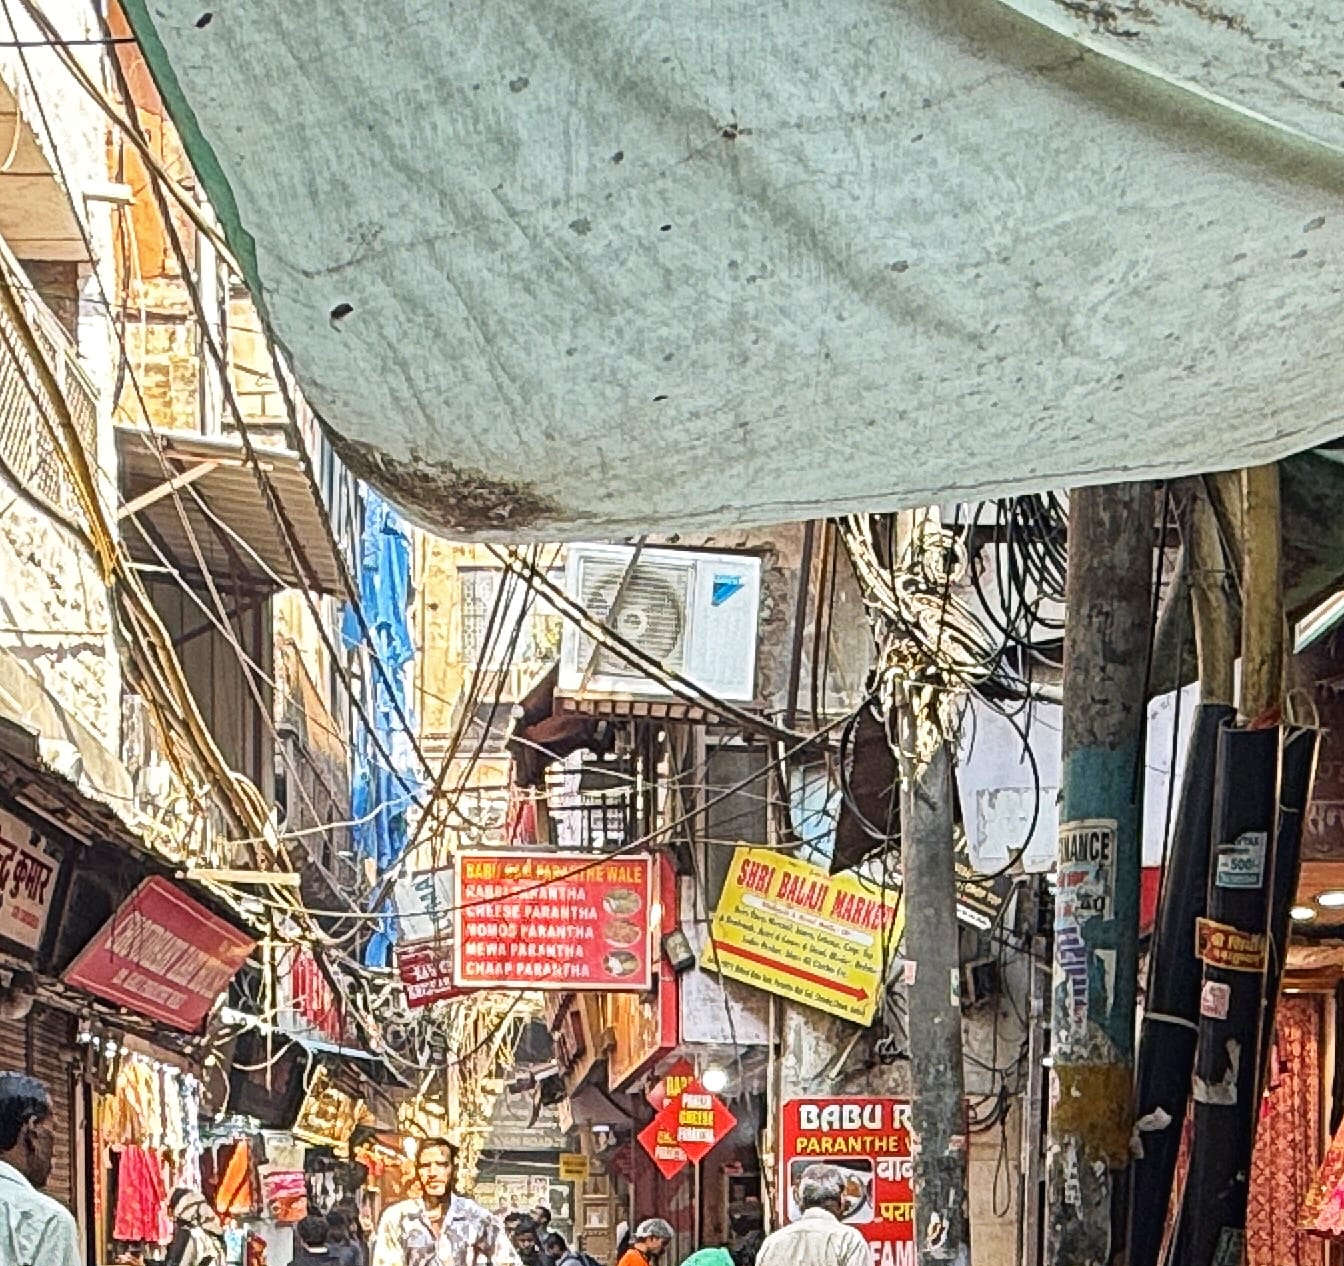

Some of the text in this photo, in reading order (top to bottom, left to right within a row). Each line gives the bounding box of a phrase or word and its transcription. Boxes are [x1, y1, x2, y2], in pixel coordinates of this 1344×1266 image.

[607, 867, 642, 883] WALE
[737, 858, 776, 894] SHRI
[776, 871, 830, 913] BALAJI
[524, 905, 597, 920] PARANTHA
[521, 923, 594, 938] PARANTHA
[511, 943, 584, 958] PARANTHA
[517, 962, 591, 977] PARANTHA
[799, 1104, 883, 1132] BABU
[797, 1136, 898, 1154] PARANTHE
